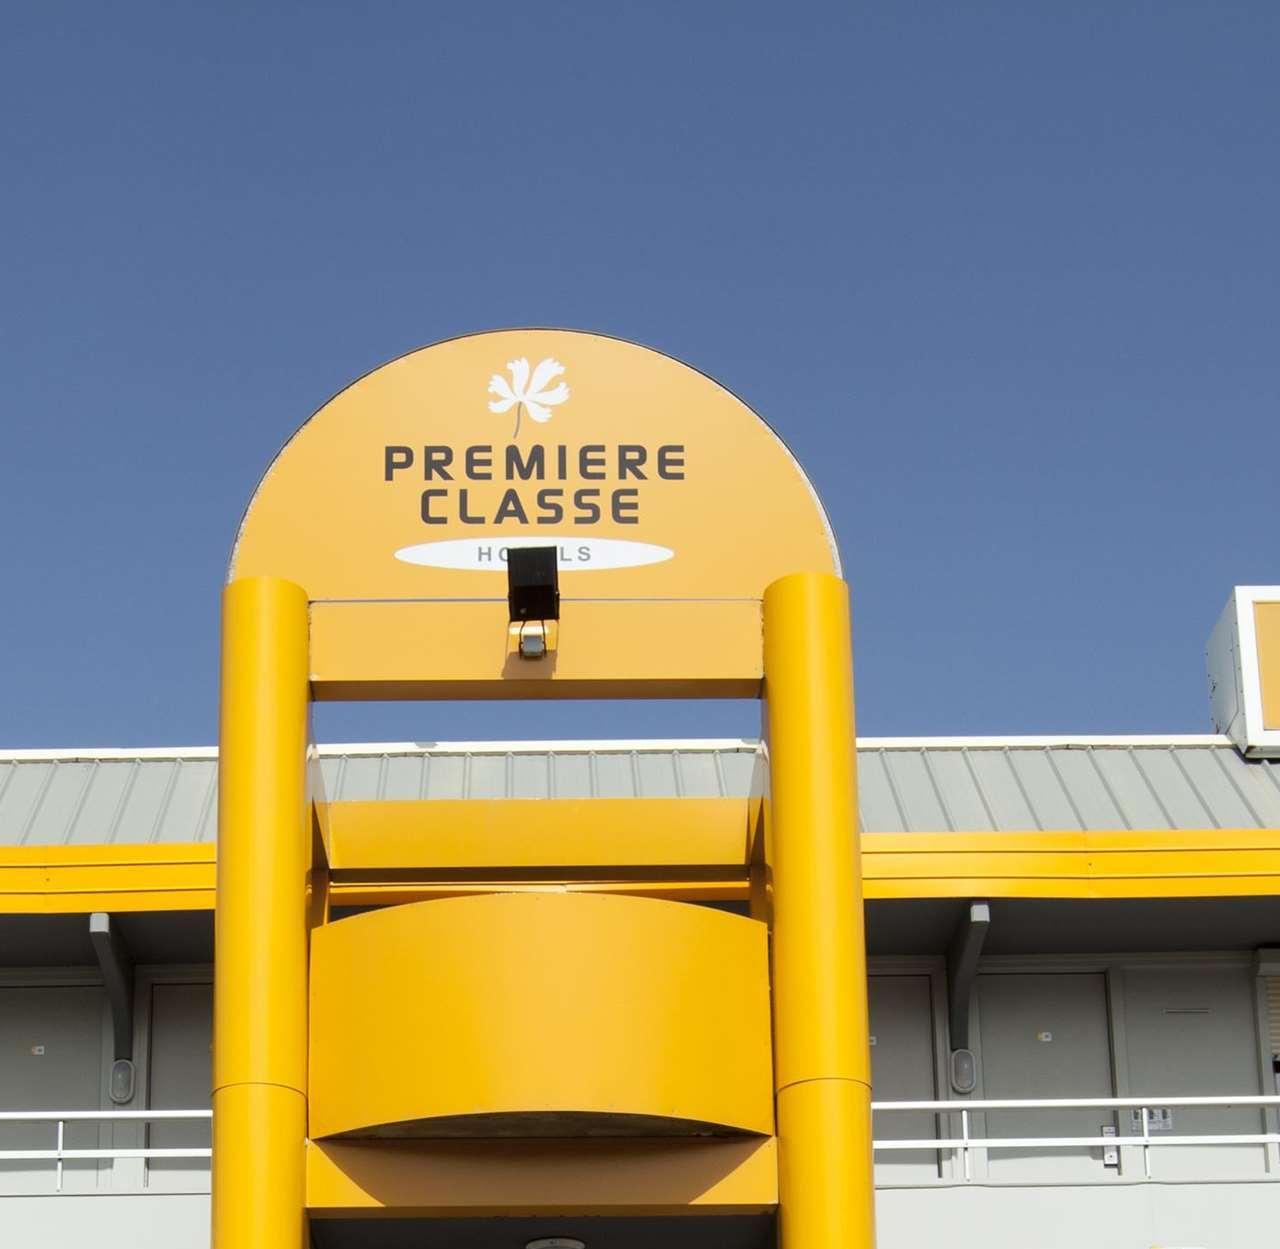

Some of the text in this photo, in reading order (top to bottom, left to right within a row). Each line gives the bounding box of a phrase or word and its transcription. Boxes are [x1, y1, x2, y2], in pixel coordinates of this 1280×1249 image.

[384, 443, 686, 482] PREMIERE
[420, 487, 639, 525] CLASSE
[477, 546, 592, 563] HOLS
